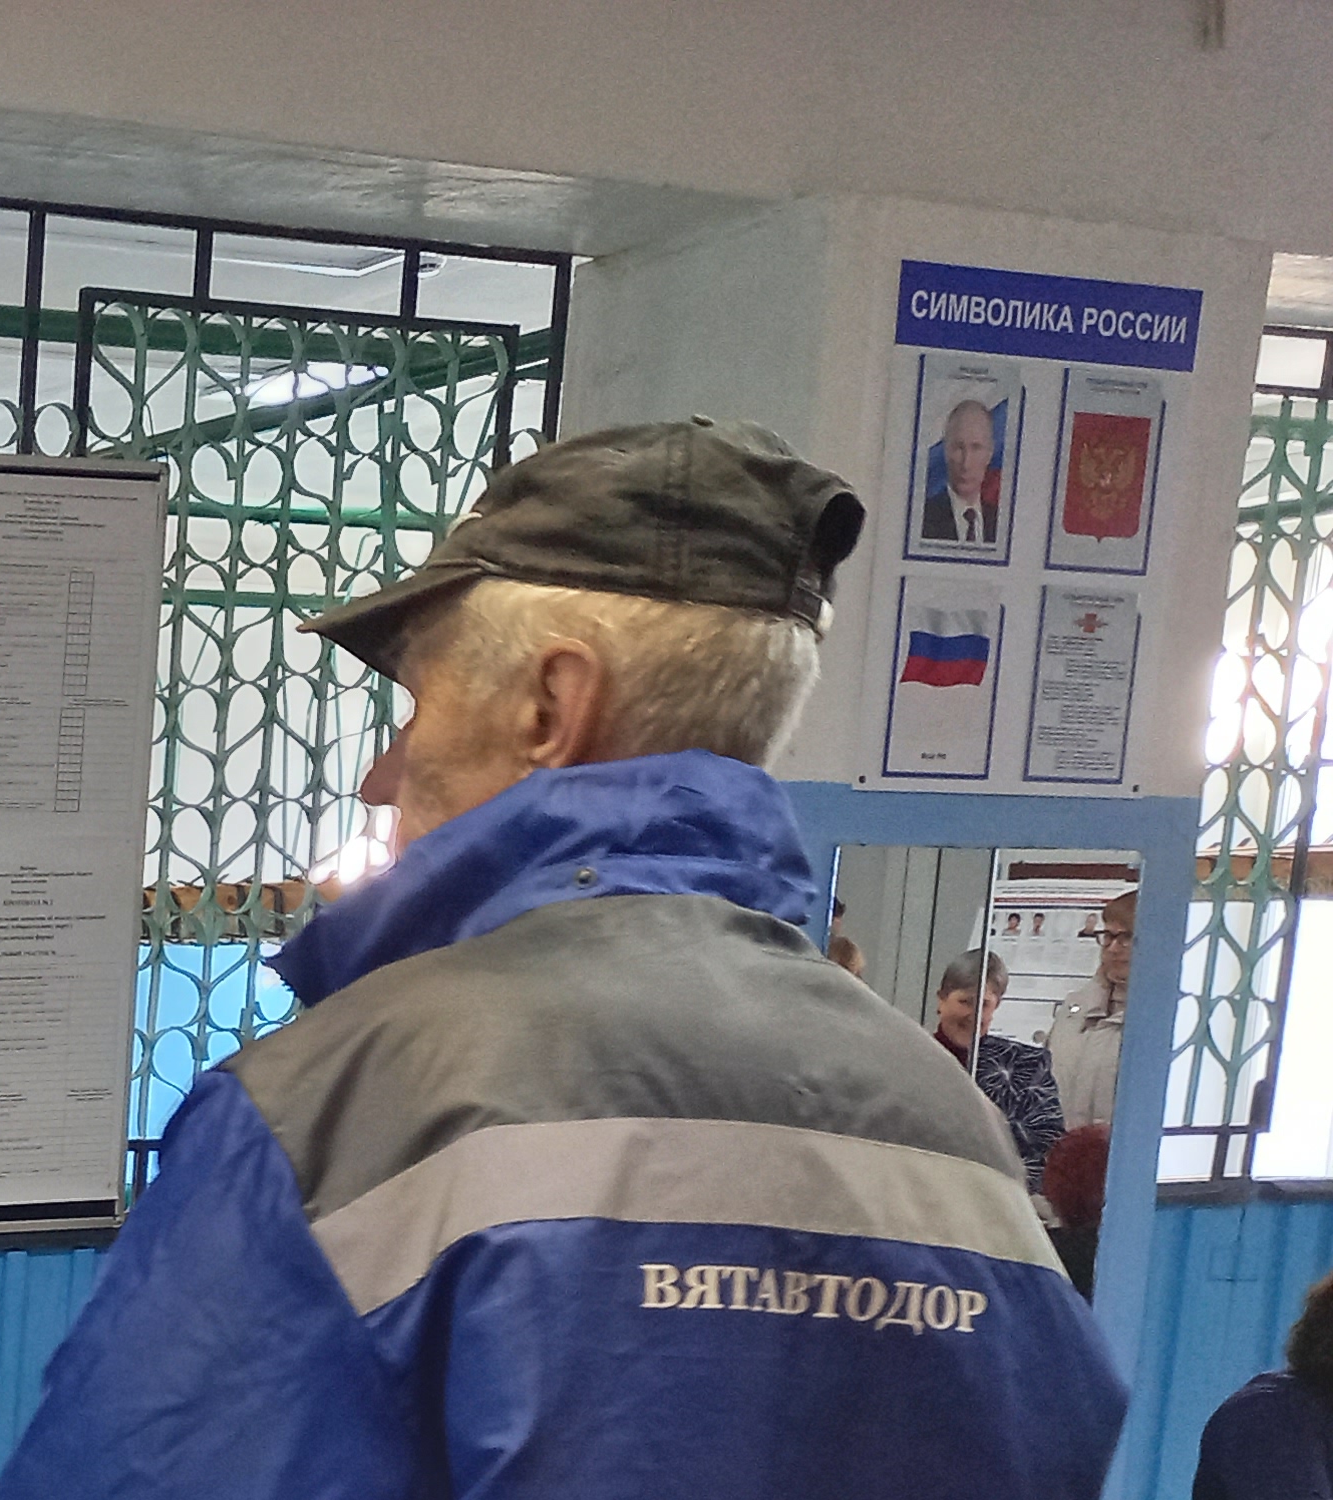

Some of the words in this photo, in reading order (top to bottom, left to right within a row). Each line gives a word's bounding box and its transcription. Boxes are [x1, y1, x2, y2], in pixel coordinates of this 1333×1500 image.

[911, 290, 1074, 334] СИМВОЛИКА
[1082, 307, 1188, 344] РОССИИ
[639, 1263, 988, 1336] ВЯТАВТОДОР
